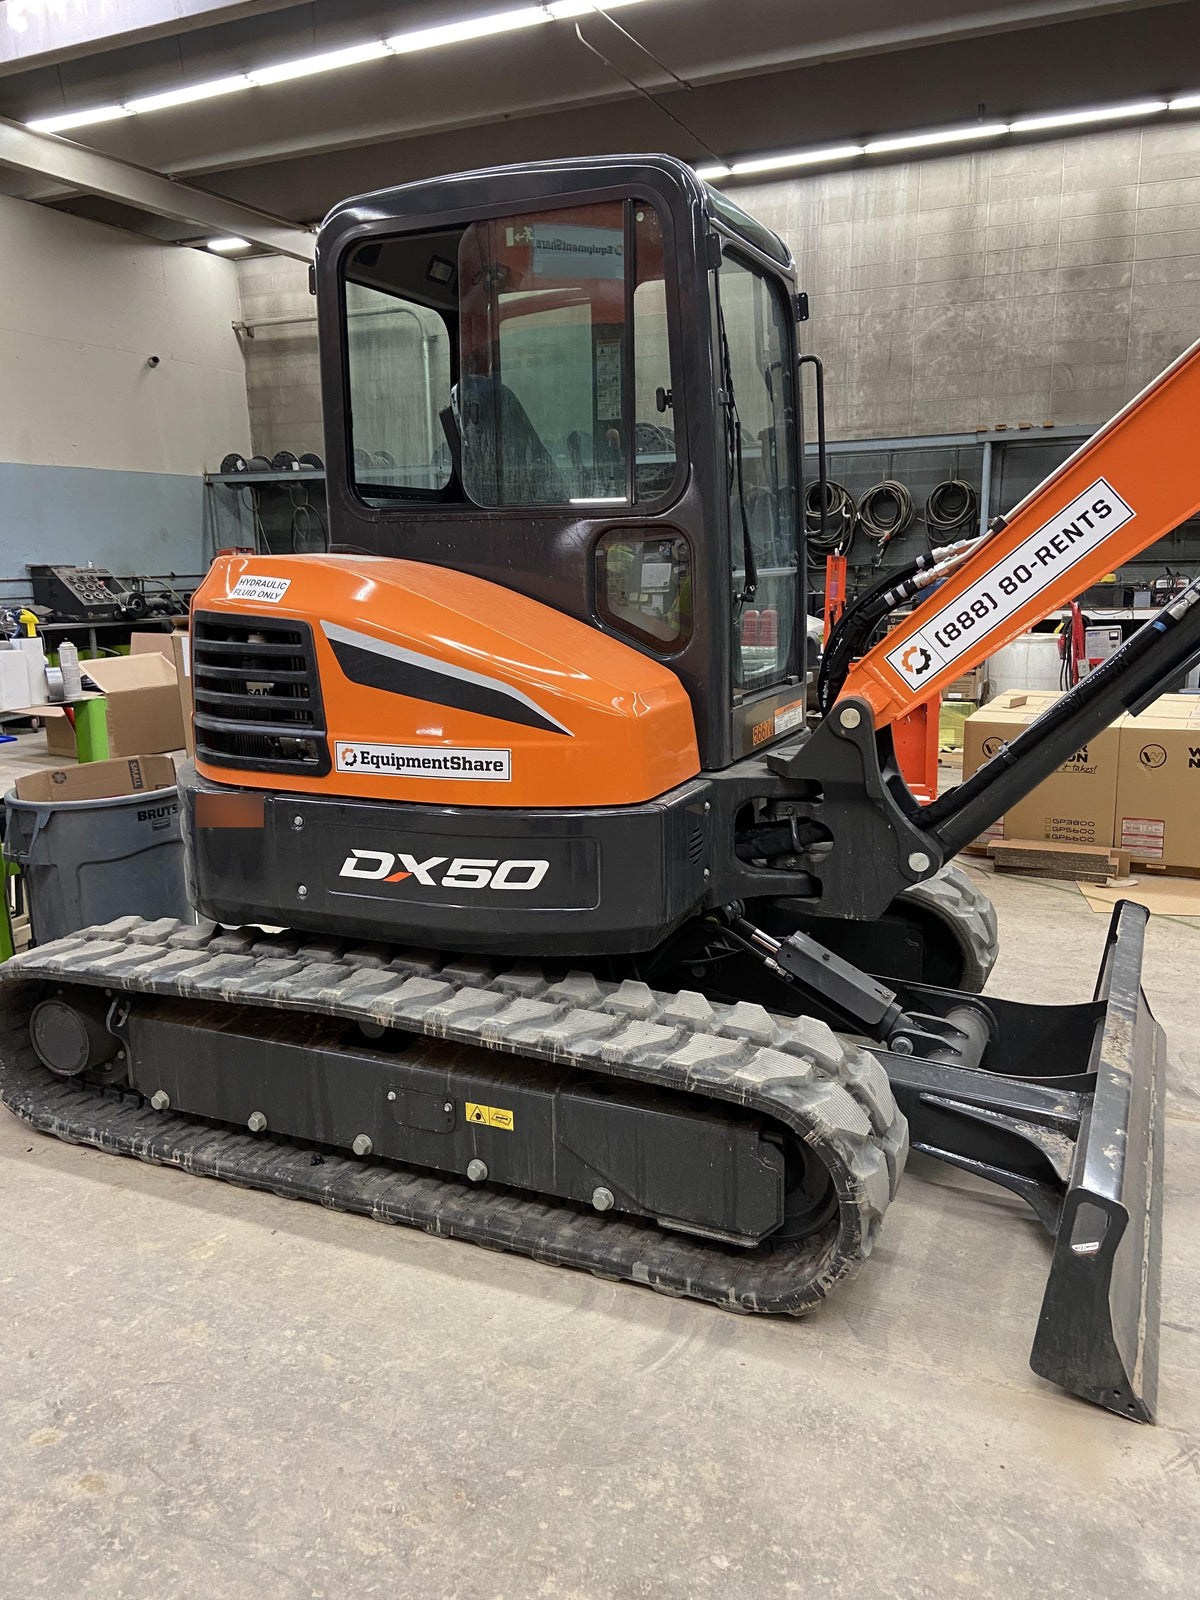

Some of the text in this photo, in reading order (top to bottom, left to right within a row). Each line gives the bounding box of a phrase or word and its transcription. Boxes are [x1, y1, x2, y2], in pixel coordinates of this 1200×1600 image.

[934, 499, 1112, 648] (888) 80-RENTS
[239, 578, 287, 590] HYDRAULIC
[232, 588, 281, 600] FLUID ONLY
[360, 750, 504, 772] EquipmentShare
[130, 761, 141, 788] SMALL
[1052, 818, 1096, 827] GP3800
[1052, 826, 1096, 835] GP5600
[1051, 833, 1095, 843] GP6600
[338, 848, 550, 890] DX50
